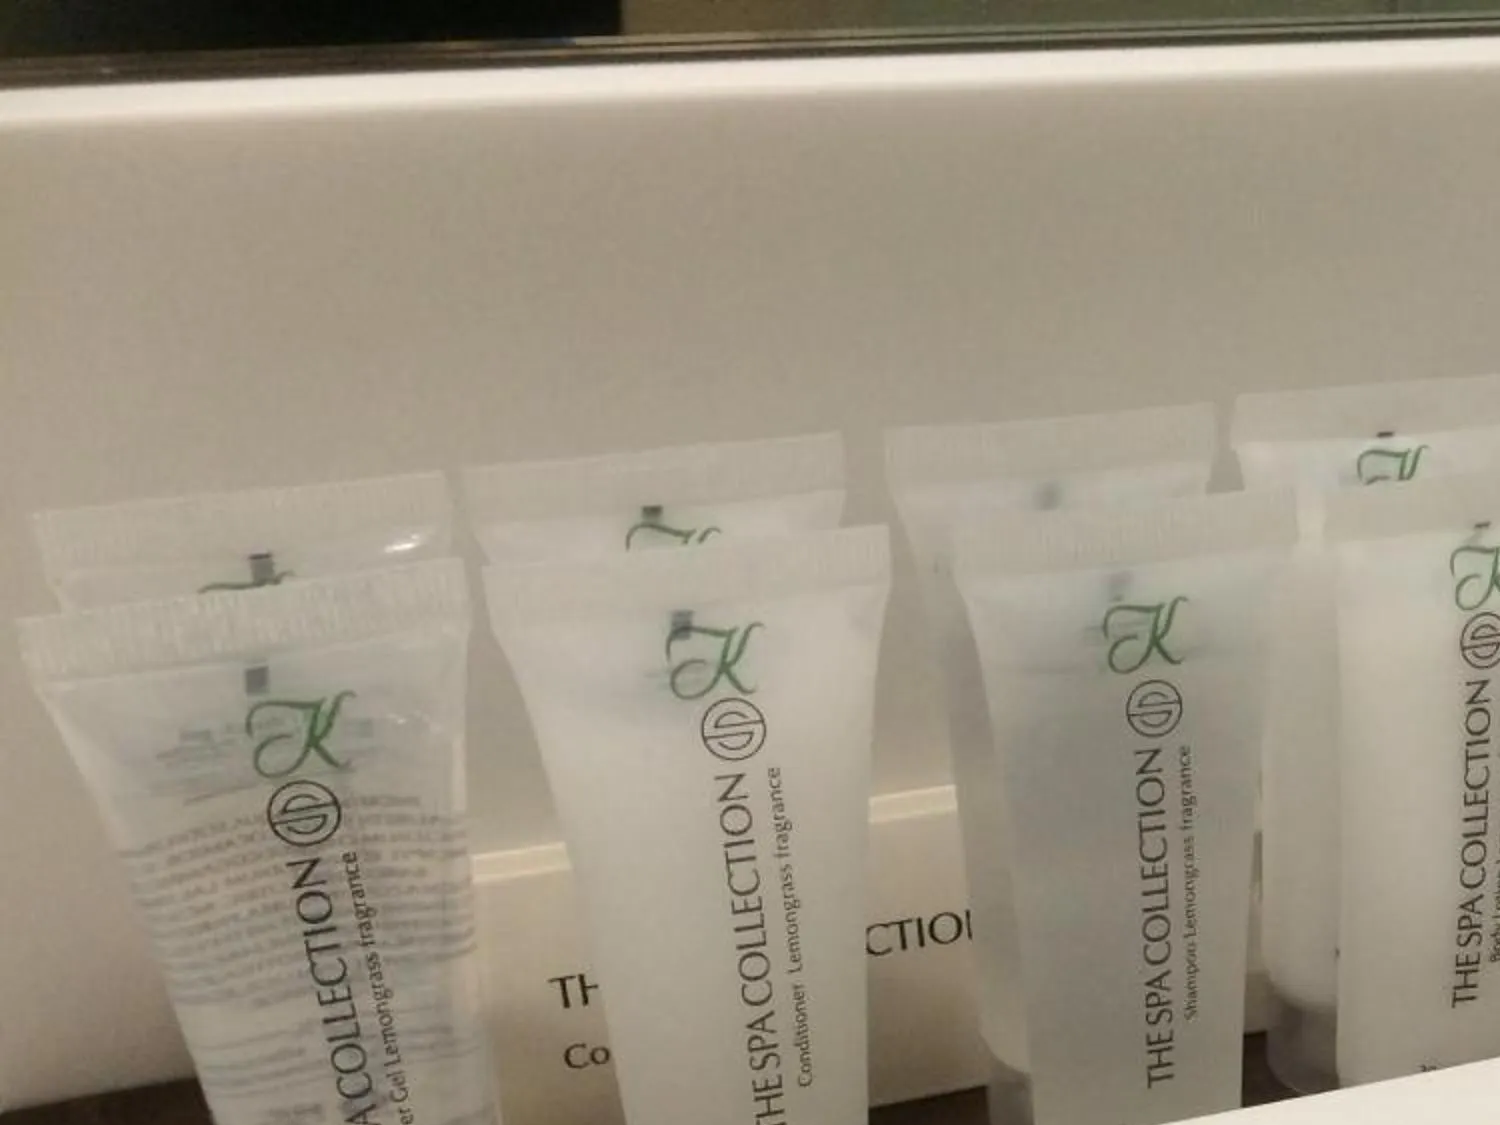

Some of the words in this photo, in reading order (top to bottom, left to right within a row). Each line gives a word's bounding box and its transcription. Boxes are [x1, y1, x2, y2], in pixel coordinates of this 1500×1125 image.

[767, 767, 793, 859] fragrance
[1459, 679, 1491, 891] COLLECTION
[341, 852, 378, 948] fragrance
[713, 772, 773, 1007] COLLECTION
[1134, 747, 1172, 967] COLLECTION
[779, 863, 803, 974] Lemongrass
[1456, 893, 1485, 948] SPA
[284, 857, 373, 1101] COLLECTION
[365, 951, 402, 1070] Lemongrass
[1144, 969, 1173, 1026] SPA
[1451, 952, 1481, 1009] THE
[745, 1009, 781, 1069] SPA
[792, 983, 813, 1088] Conditioner
[1145, 1029, 1175, 1090] THE
